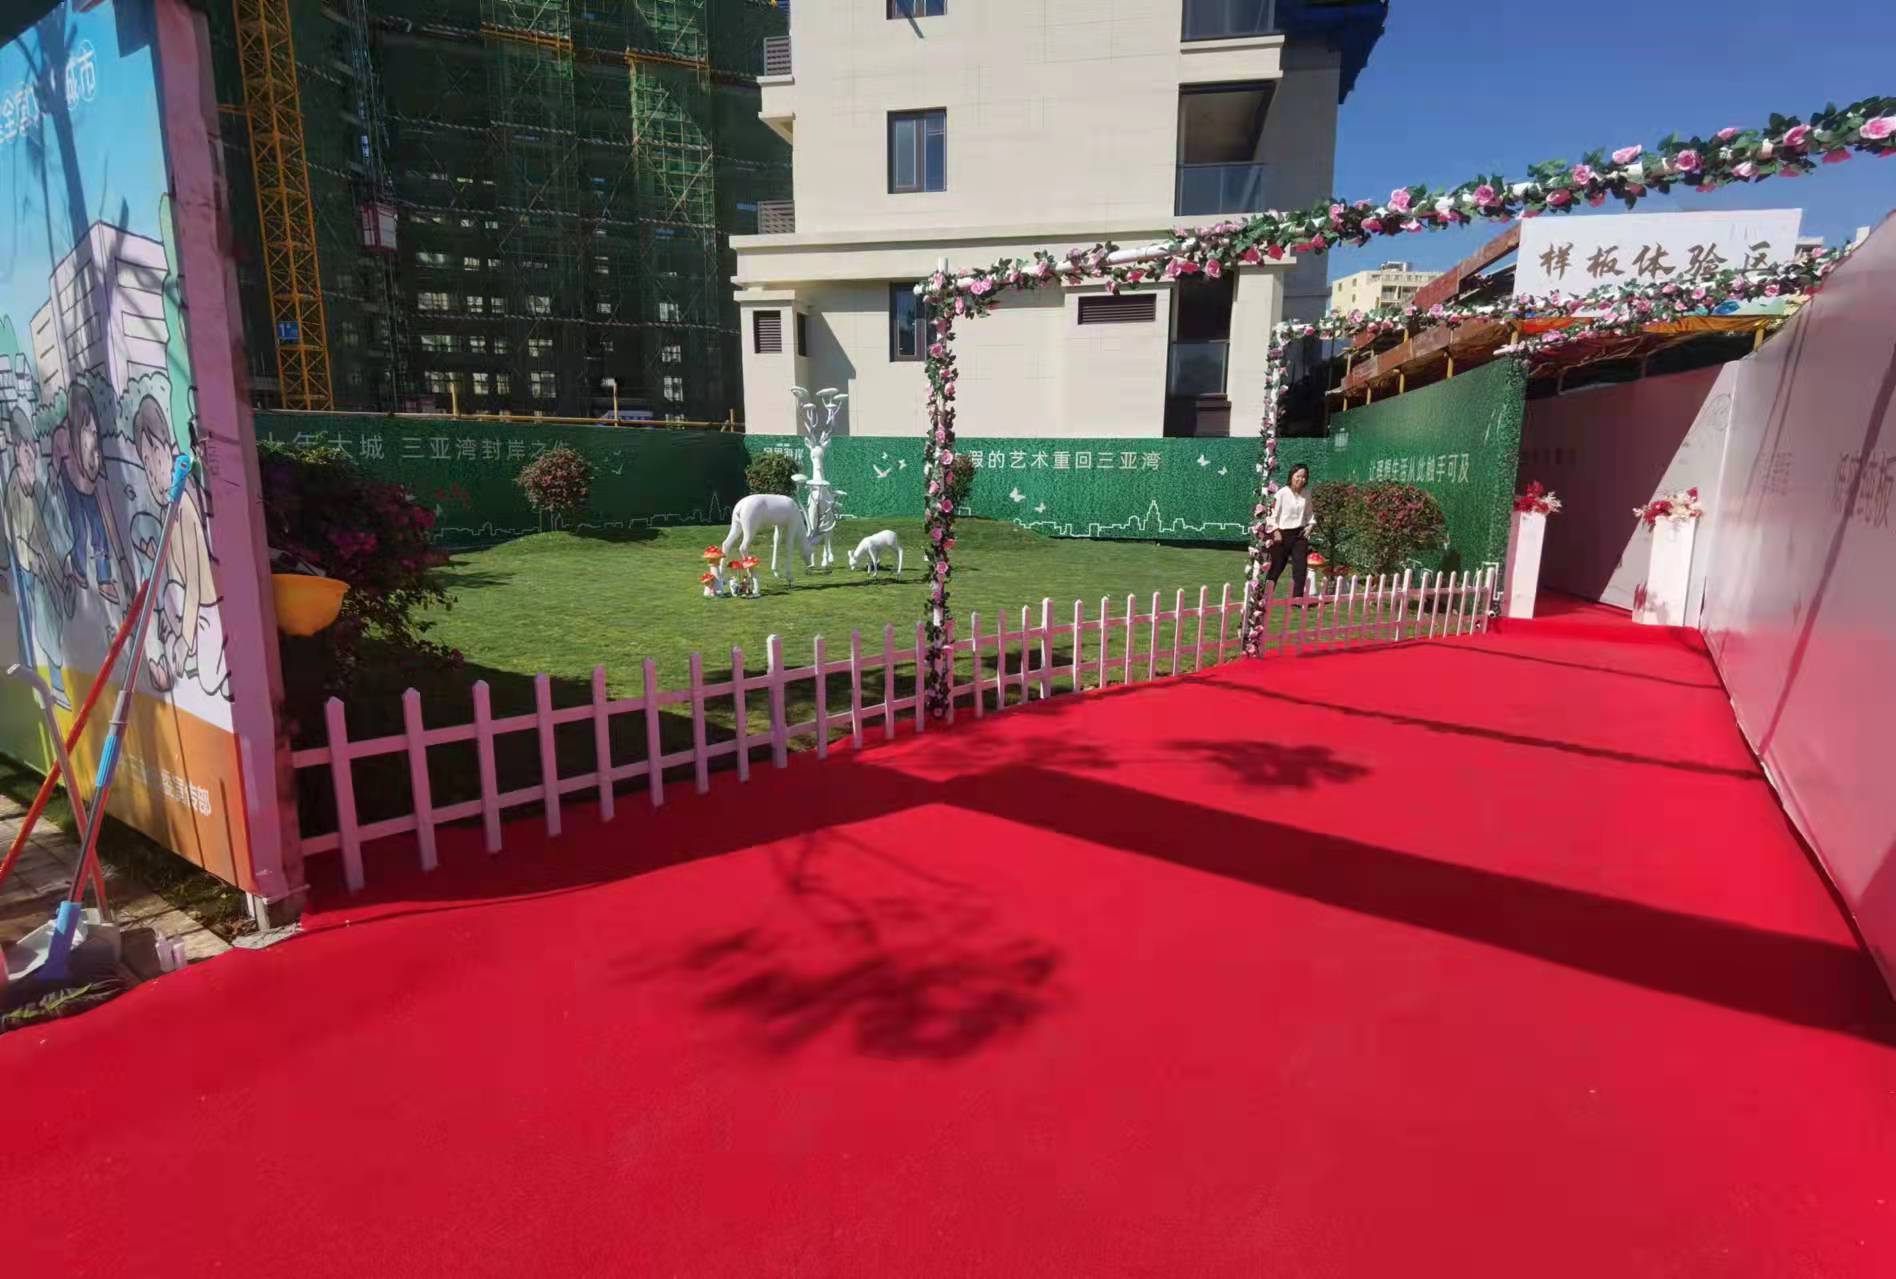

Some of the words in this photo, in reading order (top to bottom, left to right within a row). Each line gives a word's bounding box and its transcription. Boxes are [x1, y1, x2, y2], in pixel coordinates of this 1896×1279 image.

[1539, 241, 1776, 280] 样板体验区
[953, 450, 1162, 470] 假的艺术重回三亚湾
